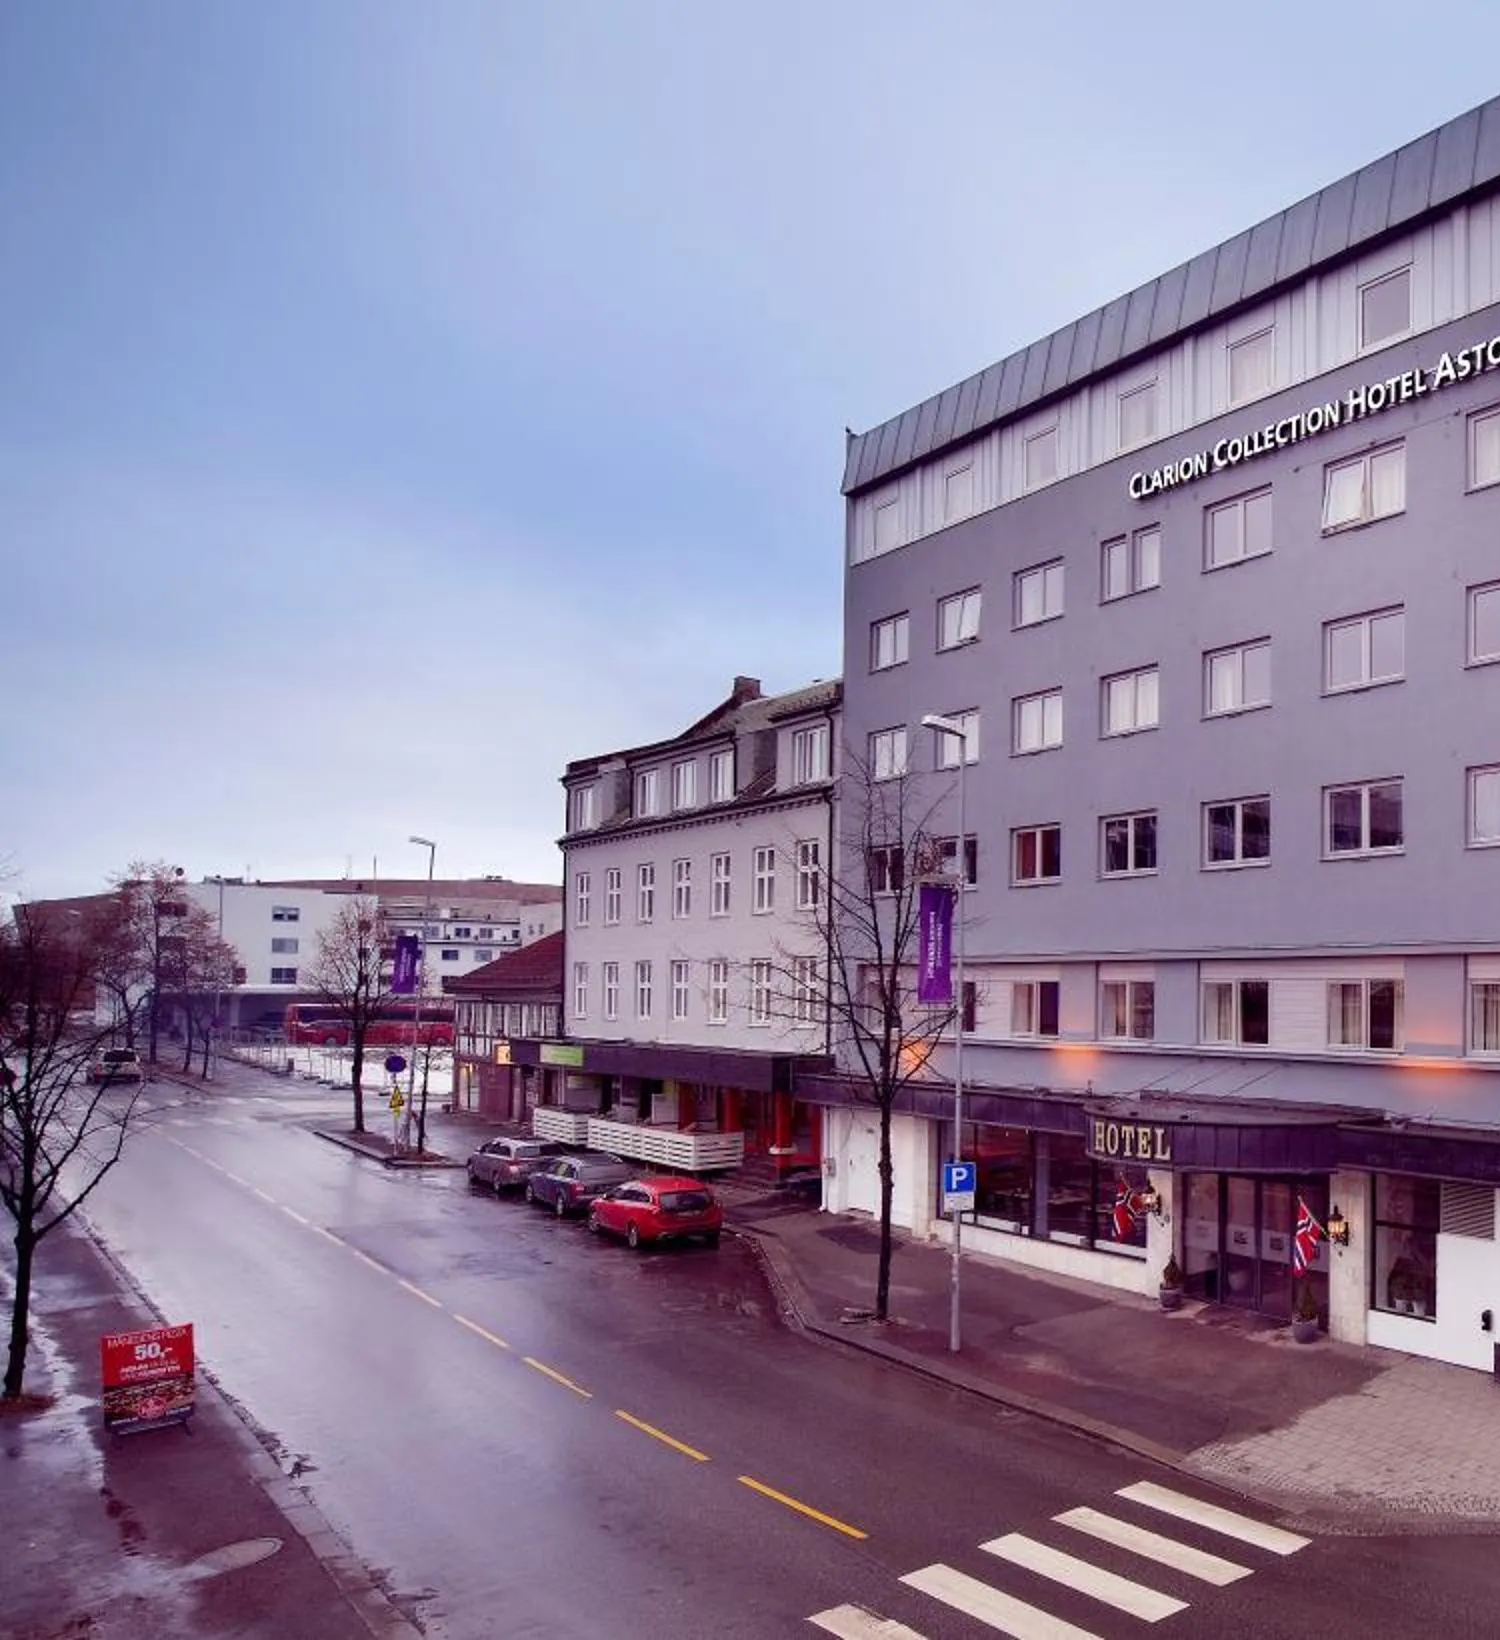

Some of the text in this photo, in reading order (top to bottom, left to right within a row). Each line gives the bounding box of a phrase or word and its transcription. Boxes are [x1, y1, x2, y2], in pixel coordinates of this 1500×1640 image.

[1129, 451, 1208, 500] CLARION
[1213, 398, 1341, 466] COLLECTION
[1347, 368, 1428, 420] HOTEL
[1094, 1121, 1171, 1161] HOTEL
[951, 1167, 968, 1189] P
[134, 1342, 174, 1361] 50,-
